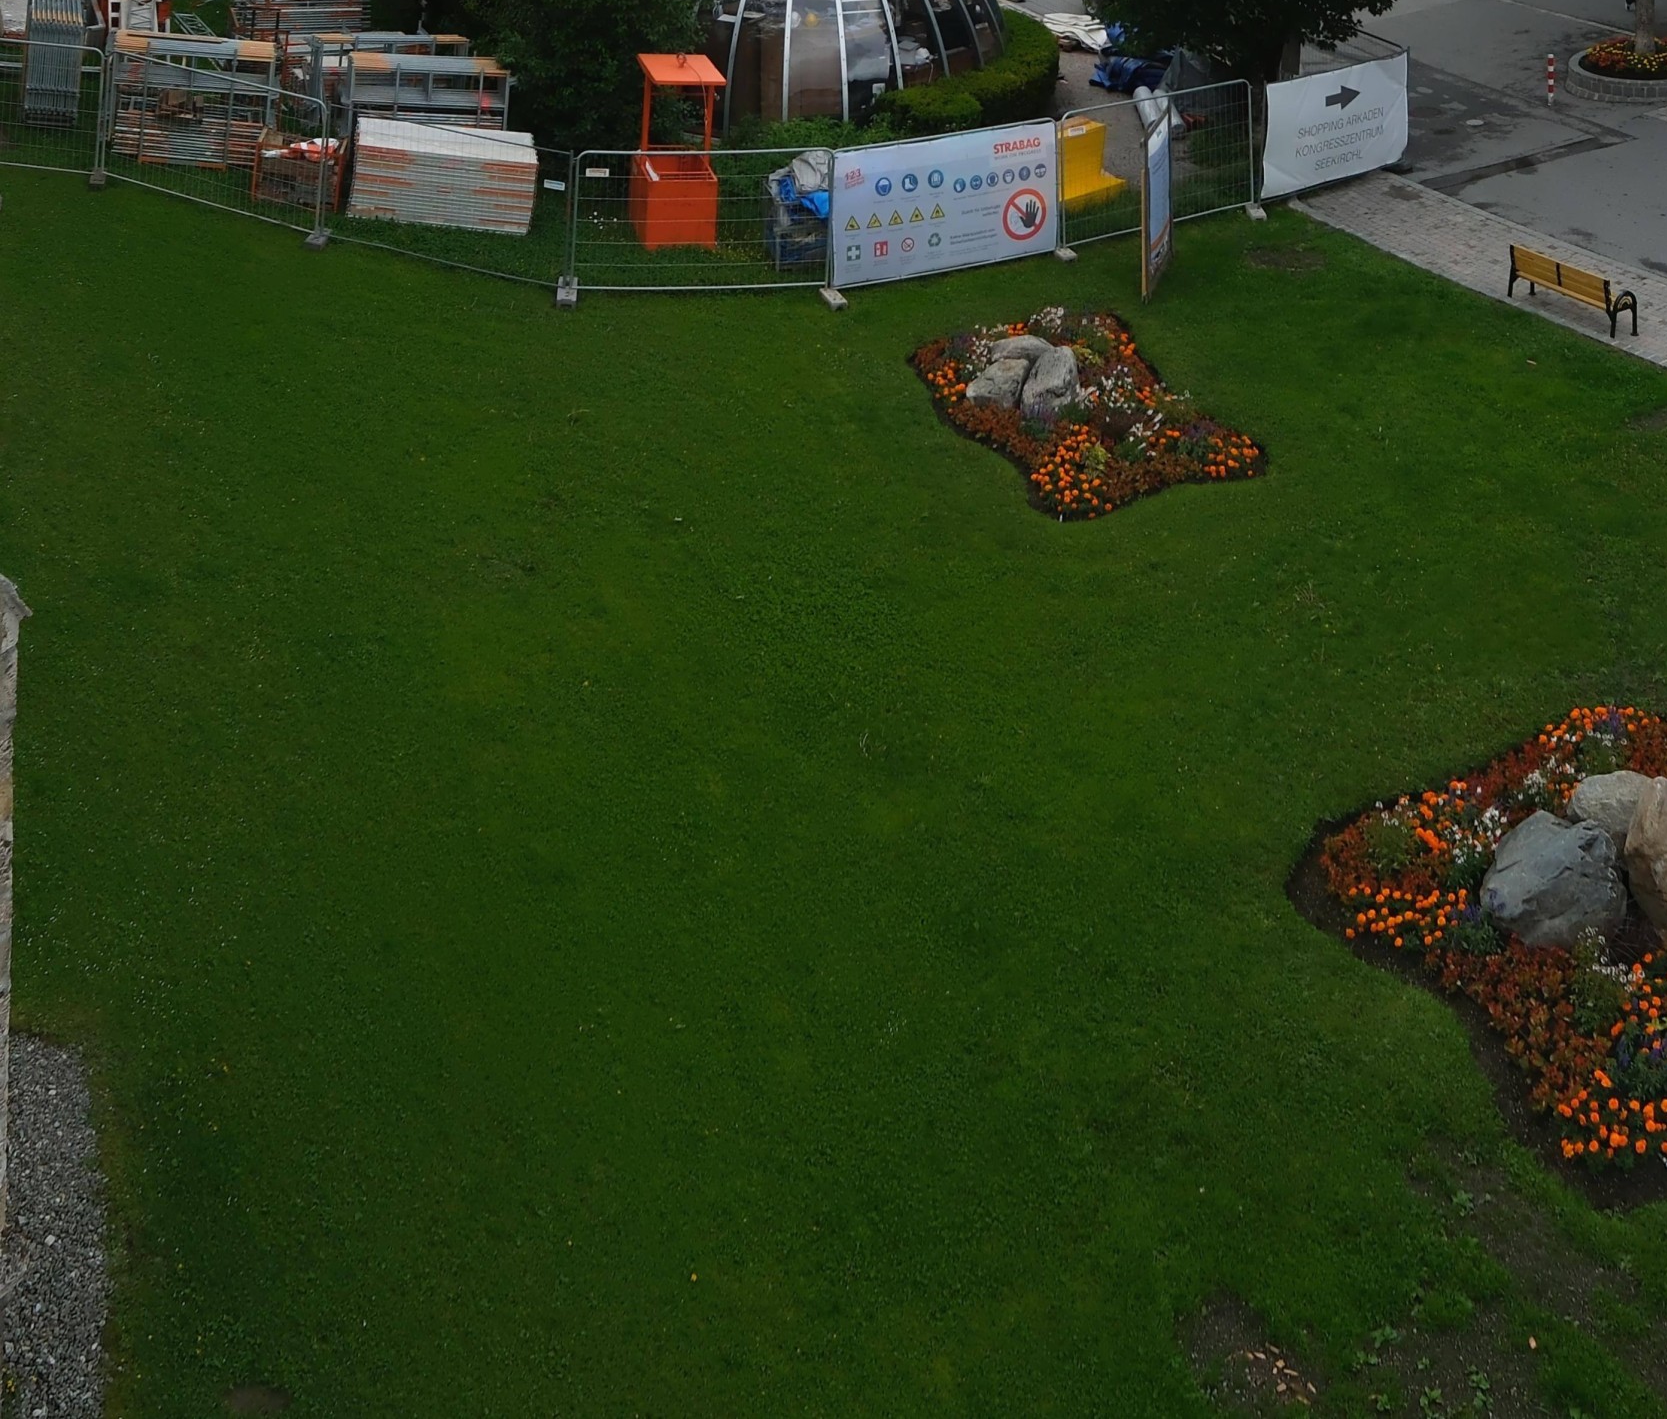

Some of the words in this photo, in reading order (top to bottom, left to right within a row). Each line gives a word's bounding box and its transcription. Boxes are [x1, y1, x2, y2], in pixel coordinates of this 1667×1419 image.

[1297, 118, 1344, 139] SHOPPING
[1346, 107, 1384, 125] ARKADEN
[993, 137, 1040, 154] STRABAG
[1295, 125, 1384, 158] KONGRESSZENTRUM
[1314, 149, 1363, 171] SEEKIRCHL
